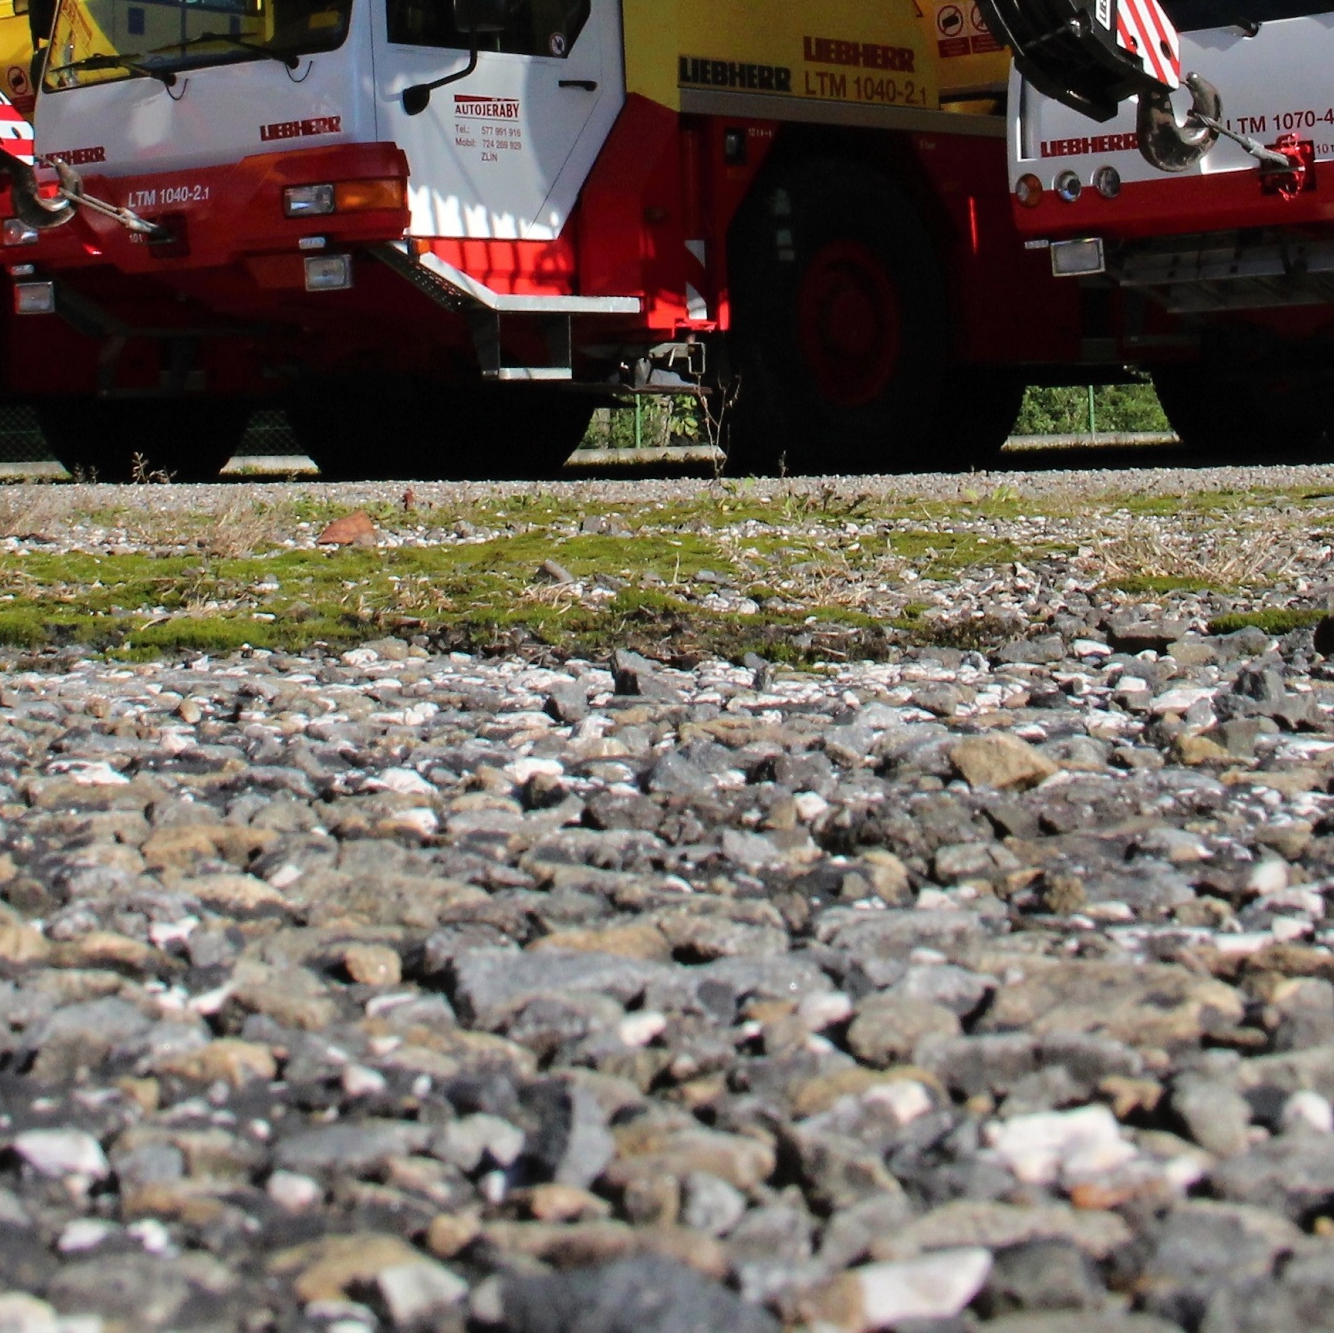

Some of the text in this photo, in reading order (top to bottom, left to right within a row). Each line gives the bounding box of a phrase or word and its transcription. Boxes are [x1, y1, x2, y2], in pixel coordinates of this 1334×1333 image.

[803, 36, 915, 73] LIEBHERR
[680, 56, 792, 92] LIEBHERR
[804, 70, 927, 105] LTM 1040-2.1
[454, 103, 520, 118] AUTOJERABY
[259, 115, 342, 141] LIEBHERR
[481, 125, 493, 135] 577
[1040, 132, 1138, 158] LIEBHERR
[1316, 143, 1329, 154] 10
[128, 184, 210, 208] LTM 1040-2.1
